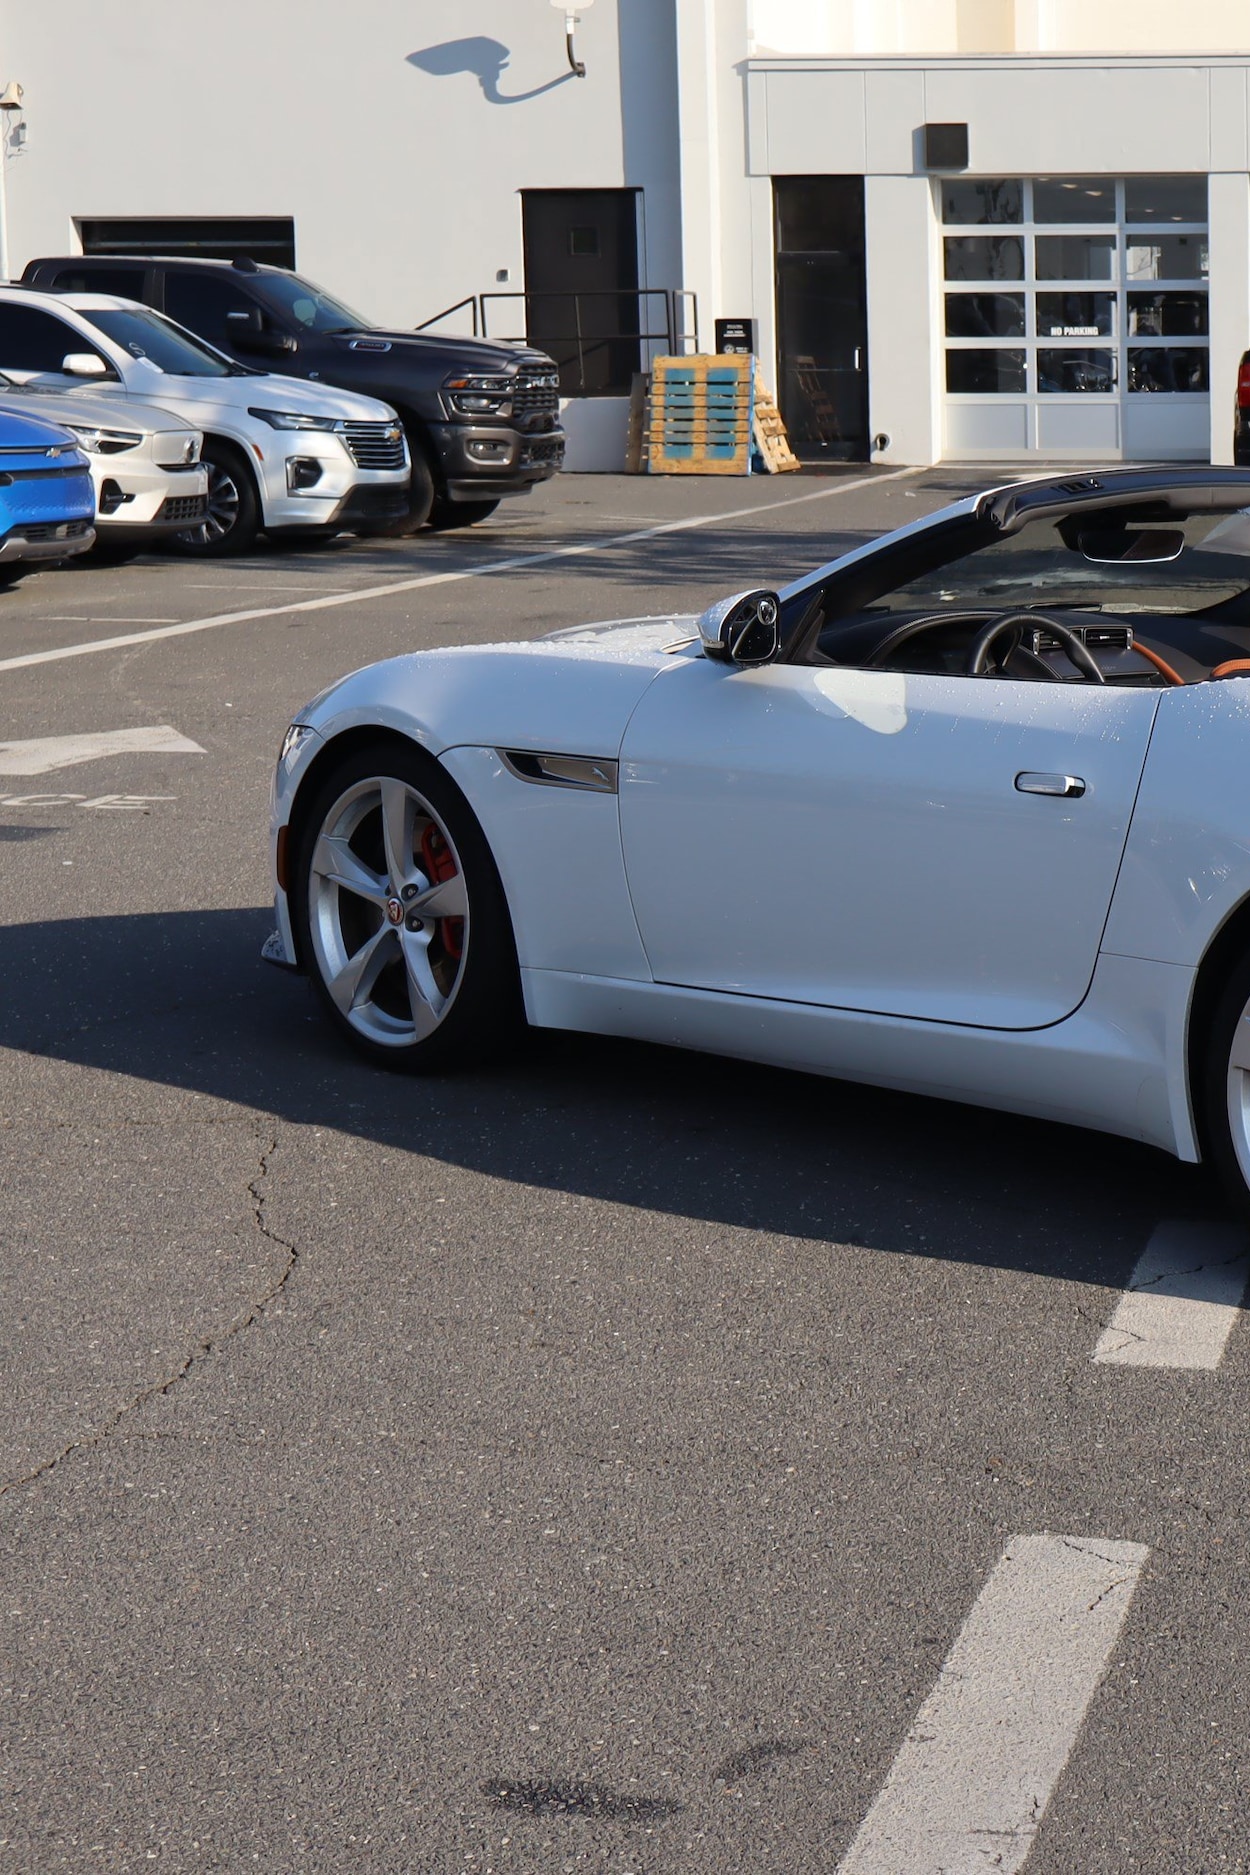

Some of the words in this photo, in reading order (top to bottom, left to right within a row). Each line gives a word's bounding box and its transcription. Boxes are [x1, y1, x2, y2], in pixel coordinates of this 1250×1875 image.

[1050, 326, 1063, 337] NO
[1063, 326, 1099, 336] PARKING
[0, 793, 179, 810] CE
